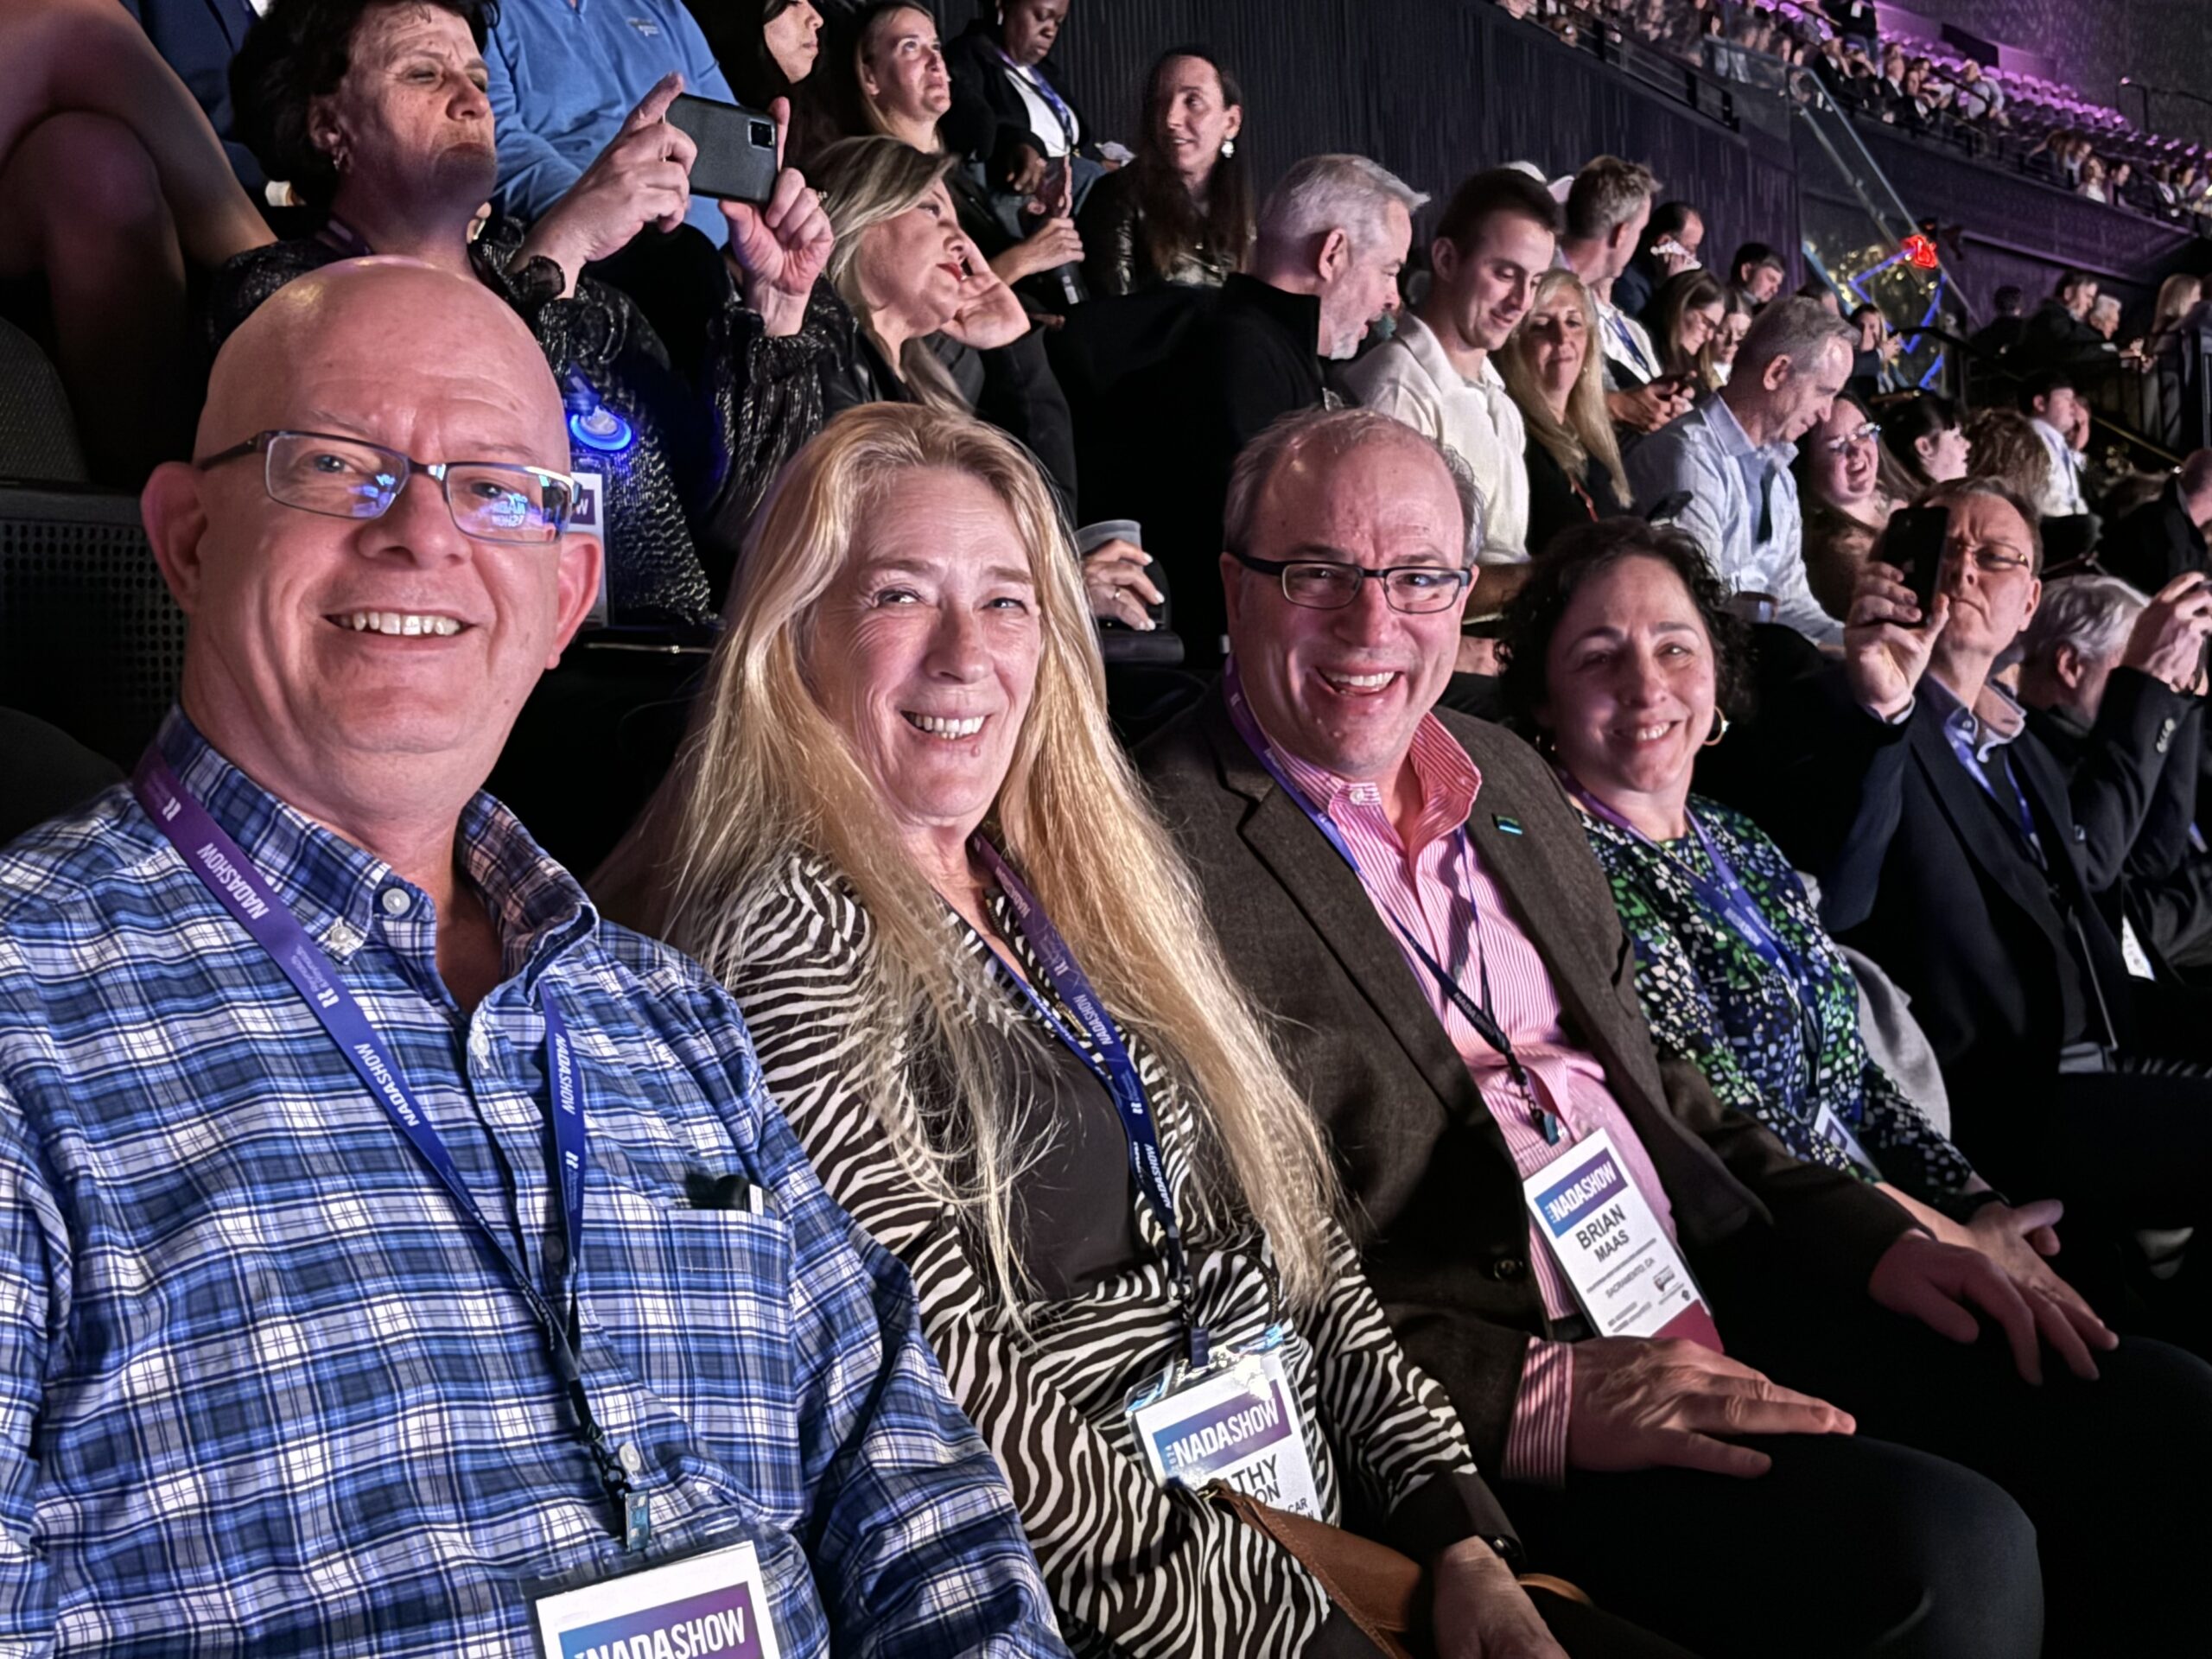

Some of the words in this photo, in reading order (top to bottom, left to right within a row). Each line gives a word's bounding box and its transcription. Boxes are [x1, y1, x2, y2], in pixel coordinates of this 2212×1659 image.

[196, 842, 270, 919] NADASHOW
[1073, 994, 1114, 1045] NADASHOW
[353, 1043, 420, 1127] NADASHOW
[555, 1033, 575, 1115] NADASHOW
[1144, 1143, 1173, 1209] NADASHOW
[1548, 1160, 1617, 1222] NADASHOW
[1575, 1204, 1626, 1250] BRIAN
[1594, 1230, 1630, 1262] MAAS
[1173, 1398, 1279, 1468] NADASHOW
